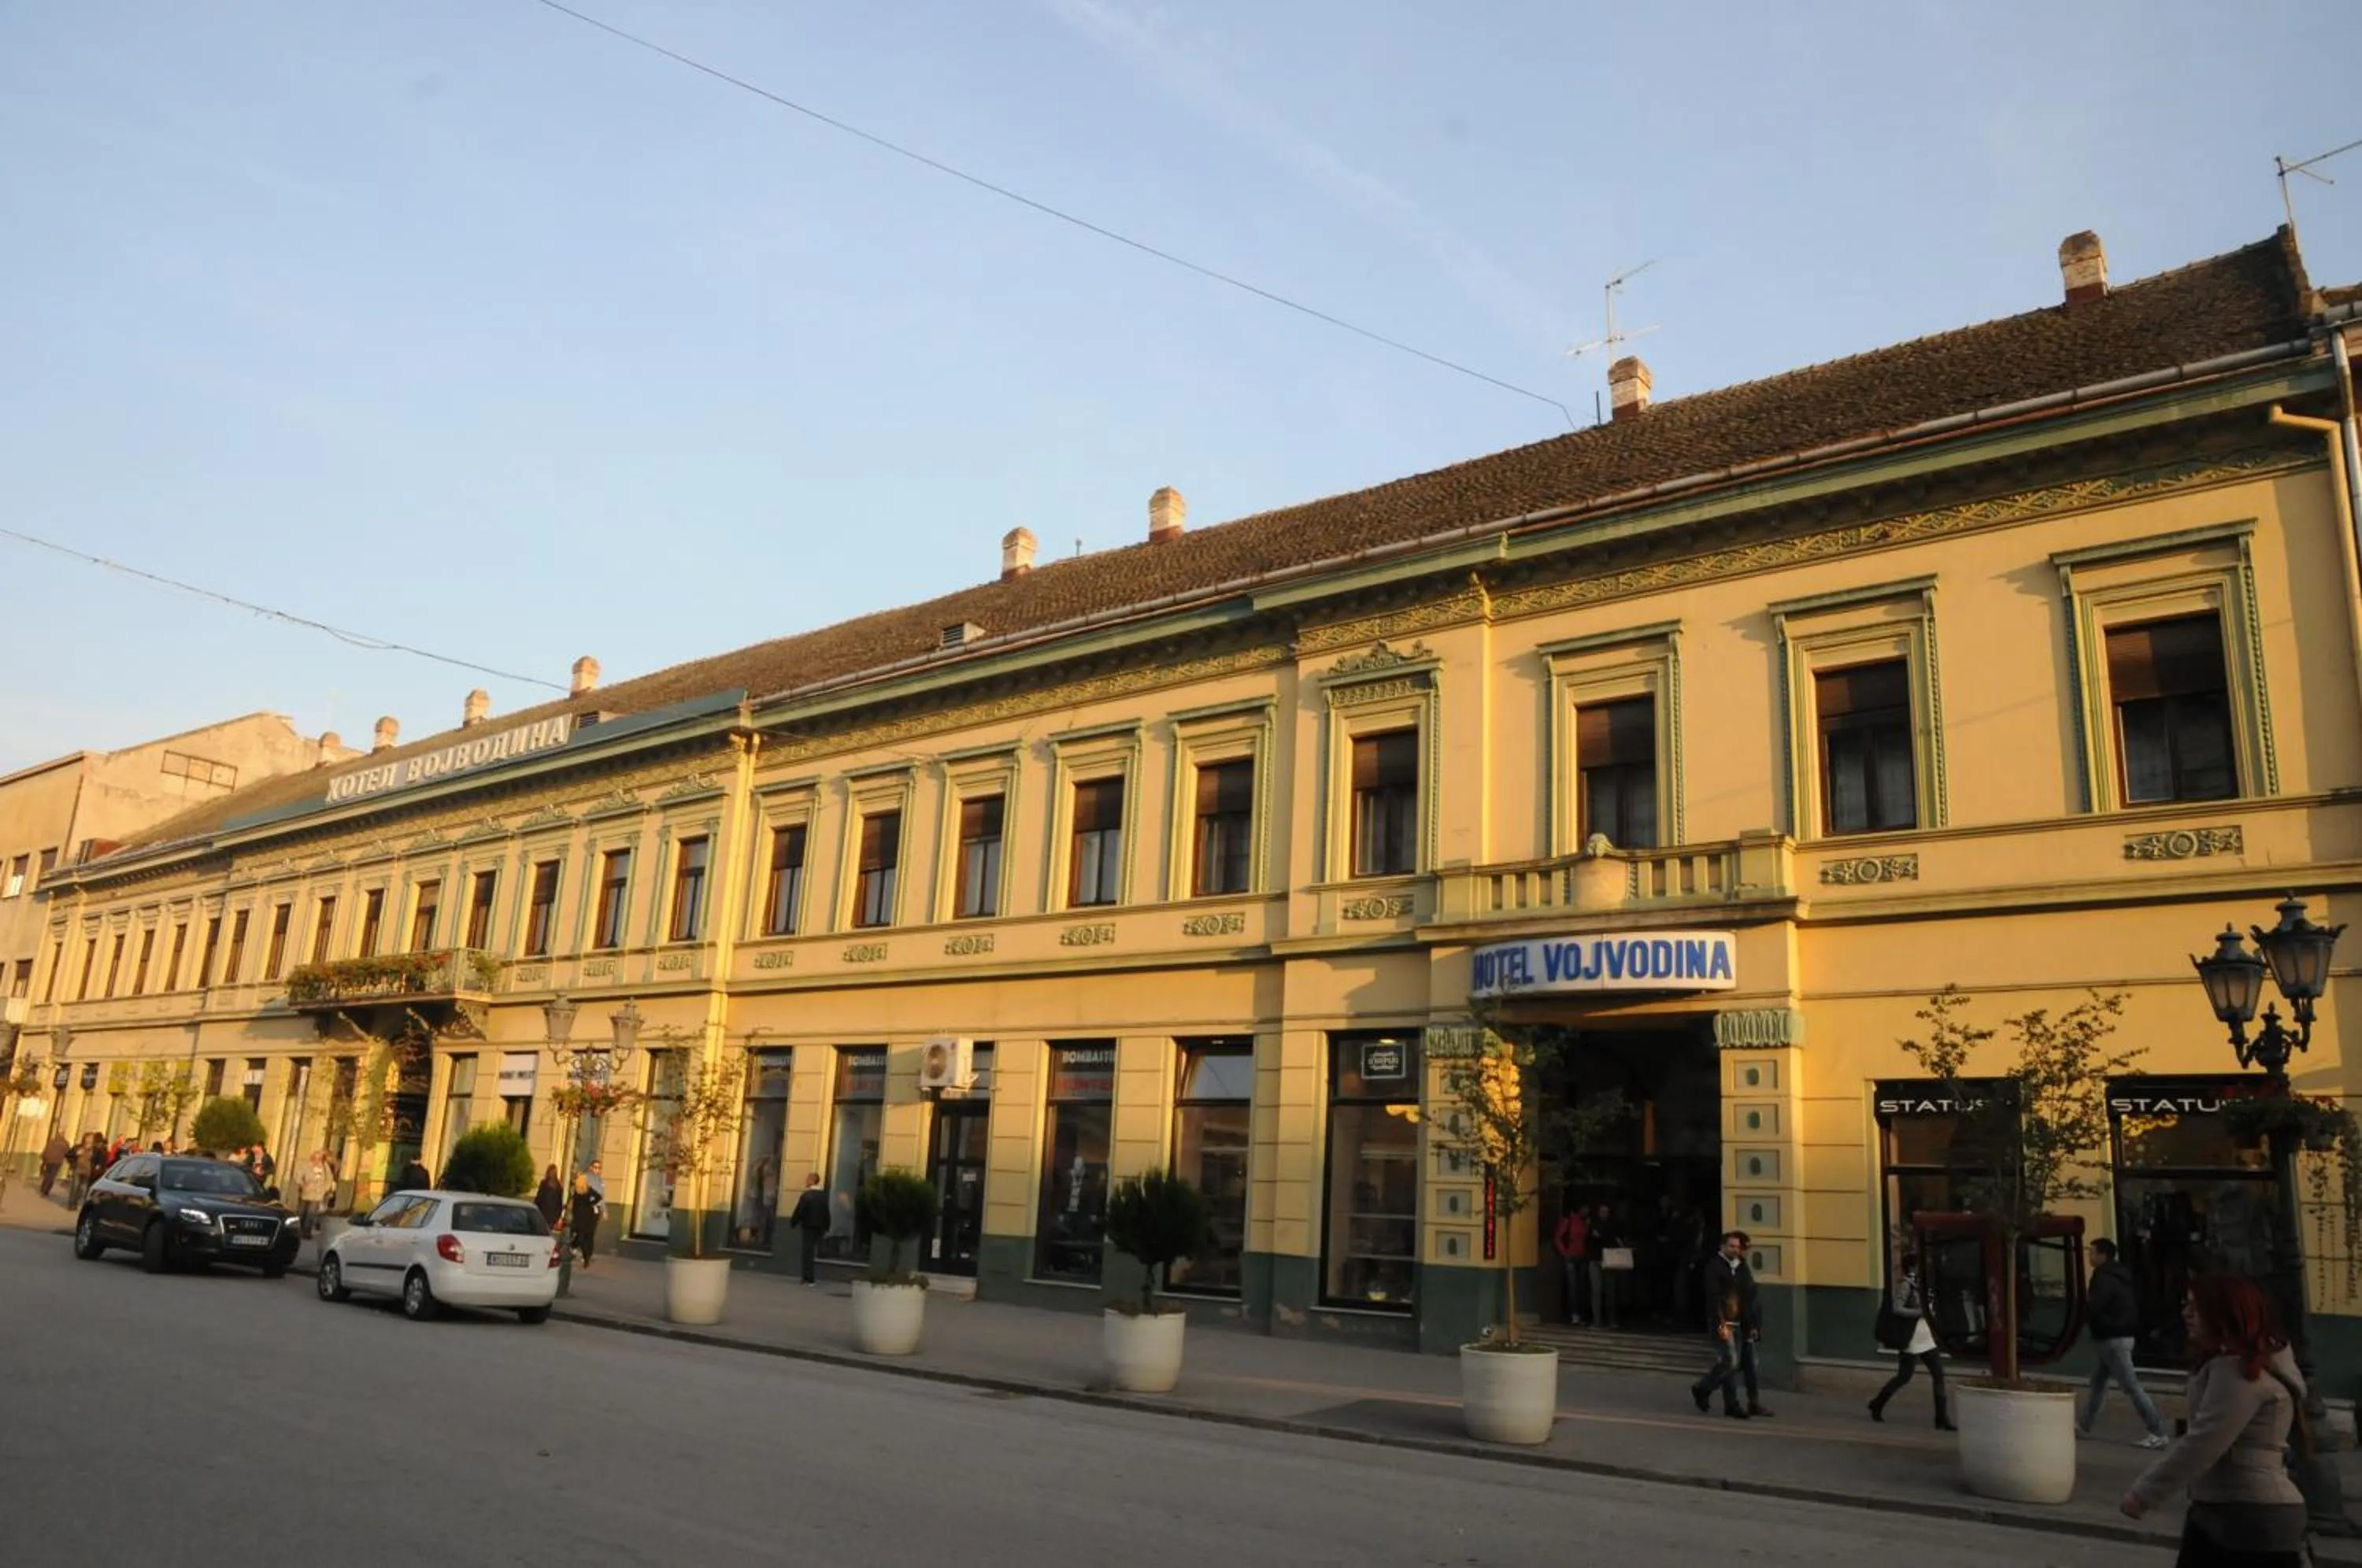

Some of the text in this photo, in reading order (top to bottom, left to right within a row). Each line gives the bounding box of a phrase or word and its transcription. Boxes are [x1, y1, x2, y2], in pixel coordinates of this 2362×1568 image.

[326, 717, 568, 801] ХОТЕЛ ВОЈВОДИНА
[1473, 940, 1732, 990] HOTEL VOJVODINA
